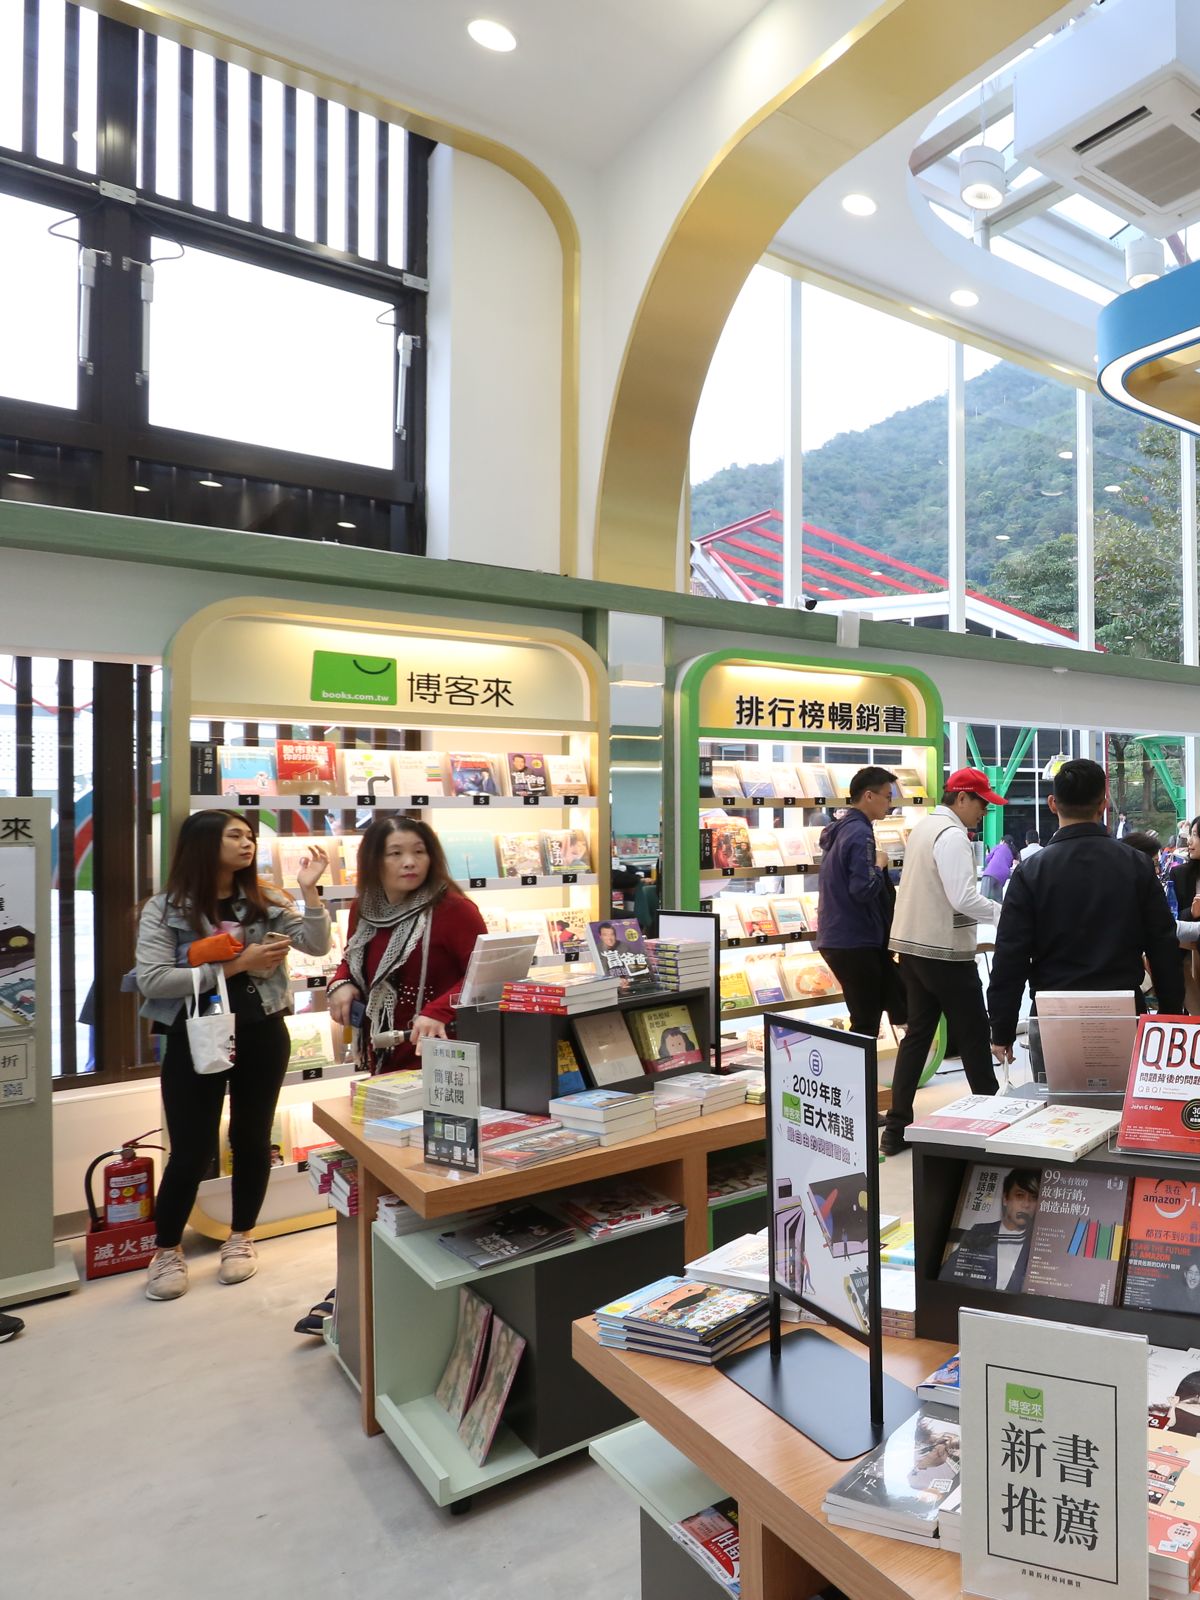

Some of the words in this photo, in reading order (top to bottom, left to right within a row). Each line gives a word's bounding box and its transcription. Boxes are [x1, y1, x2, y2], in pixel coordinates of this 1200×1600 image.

[321, 690, 389, 702] books.com.tw
[407, 671, 514, 708] 博客來
[735, 695, 906, 734] 排行榜暢銷書
[0, 817, 33, 840] 來
[1, 1055, 19, 1069] 折
[434, 1069, 464, 1086] 簡單掃
[434, 1086, 465, 1105] 好試閱
[792, 1074, 842, 1108] 2019年度
[802, 1102, 855, 1142] 百大精選
[972, 1171, 990, 1212] 說話之道
[1165, 1184, 1181, 1195] 我在
[1039, 1200, 1091, 1216] 創造品牌力
[1143, 1194, 1181, 1205] amazon
[94, 1234, 158, 1261] 滅火器
[1139, 1252, 1172, 1262] AMAZON
[1166, 1245, 1192, 1256] FUTURE
[1008, 1398, 1043, 1416] 博客來
[1001, 1421, 1100, 1488] 新書
[1001, 1482, 1101, 1551] 推薦
